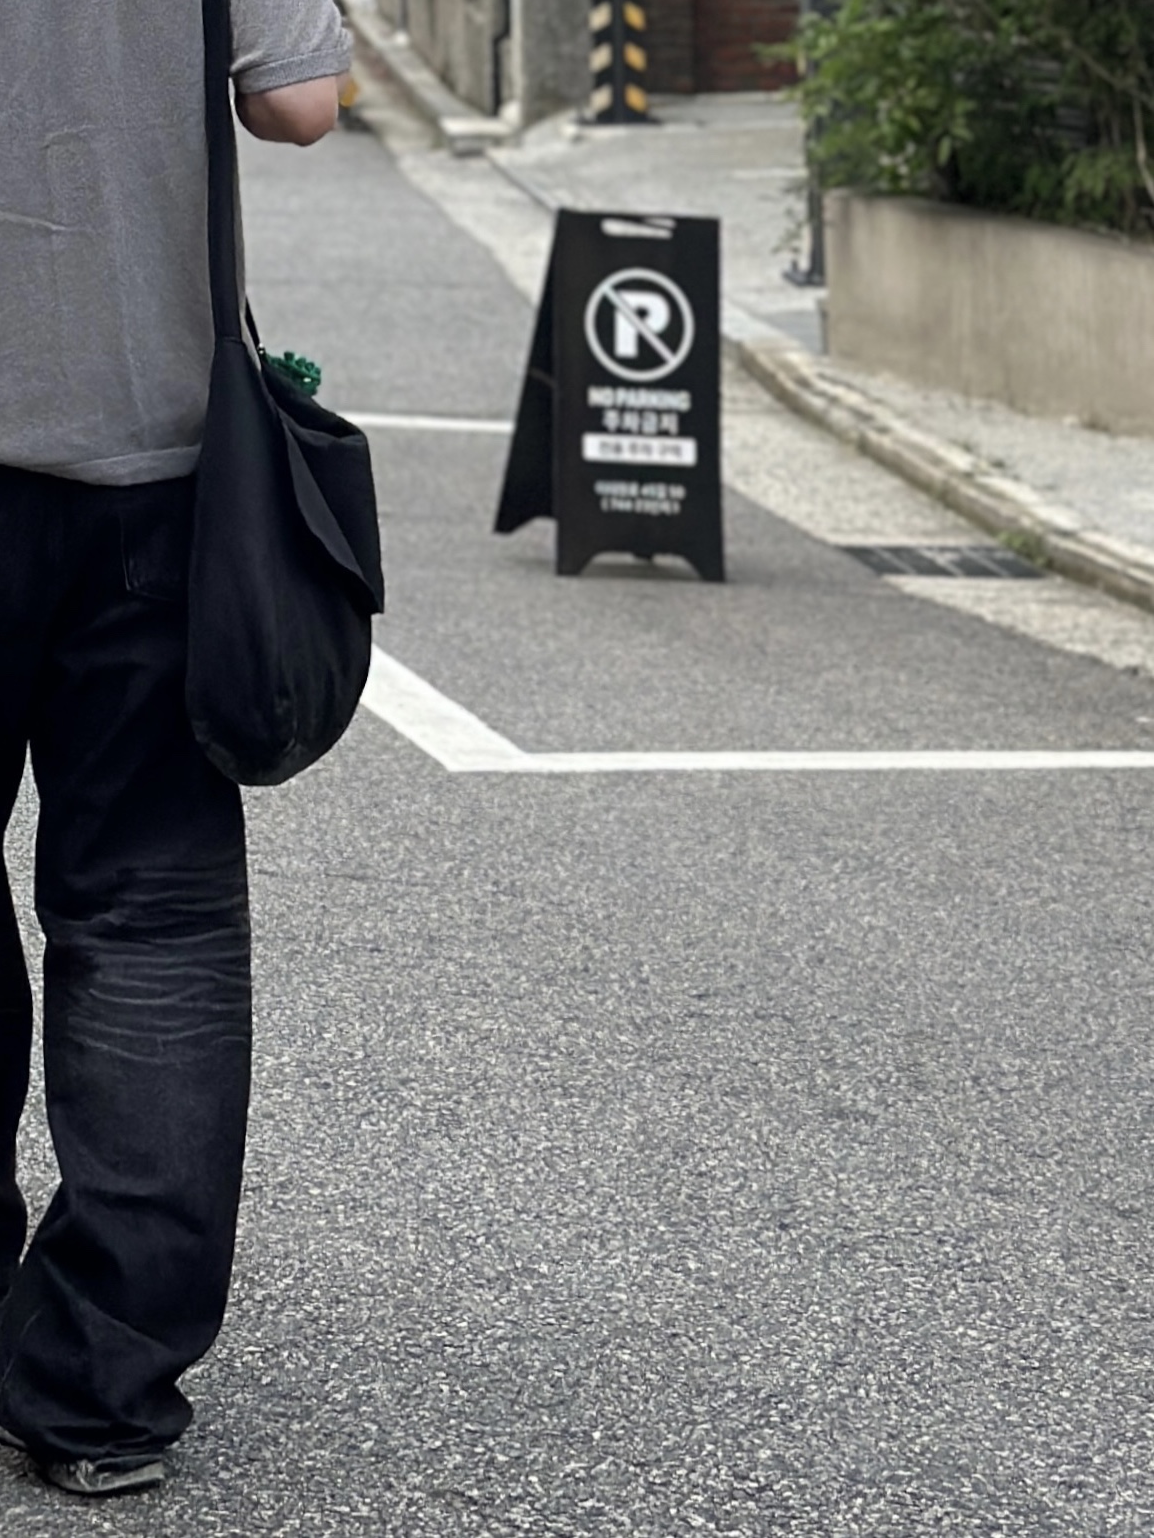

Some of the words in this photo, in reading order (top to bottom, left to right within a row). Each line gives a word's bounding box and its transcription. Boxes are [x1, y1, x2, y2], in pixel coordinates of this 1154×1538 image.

[614, 290, 672, 359] P
[588, 387, 613, 407] NO
[616, 387, 692, 413] PARKING
[602, 409, 678, 435] 주차금지
